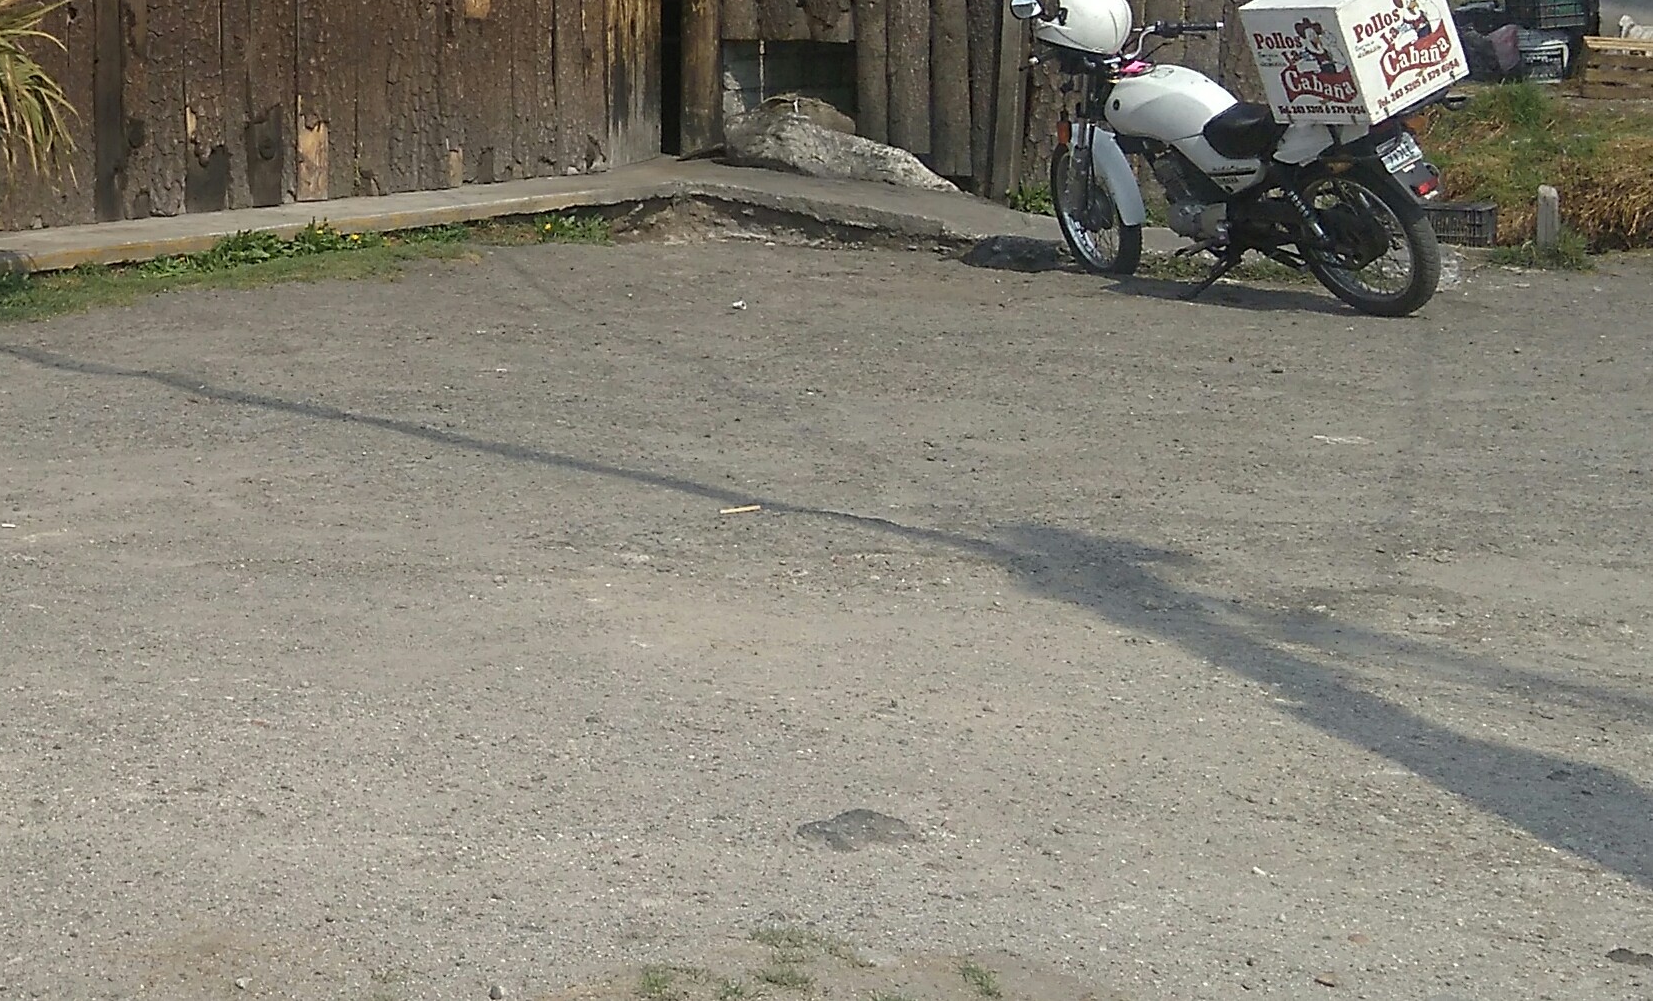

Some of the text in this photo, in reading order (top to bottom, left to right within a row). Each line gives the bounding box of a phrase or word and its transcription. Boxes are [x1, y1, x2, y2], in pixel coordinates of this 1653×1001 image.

[1353, 8, 1401, 43] Pollos
[1380, 26, 1400, 45] La
[1253, 32, 1303, 50] Pollos
[1282, 50, 1302, 65] La
[1382, 36, 1450, 76] Cabaña
[1284, 70, 1356, 101] Cabaña
